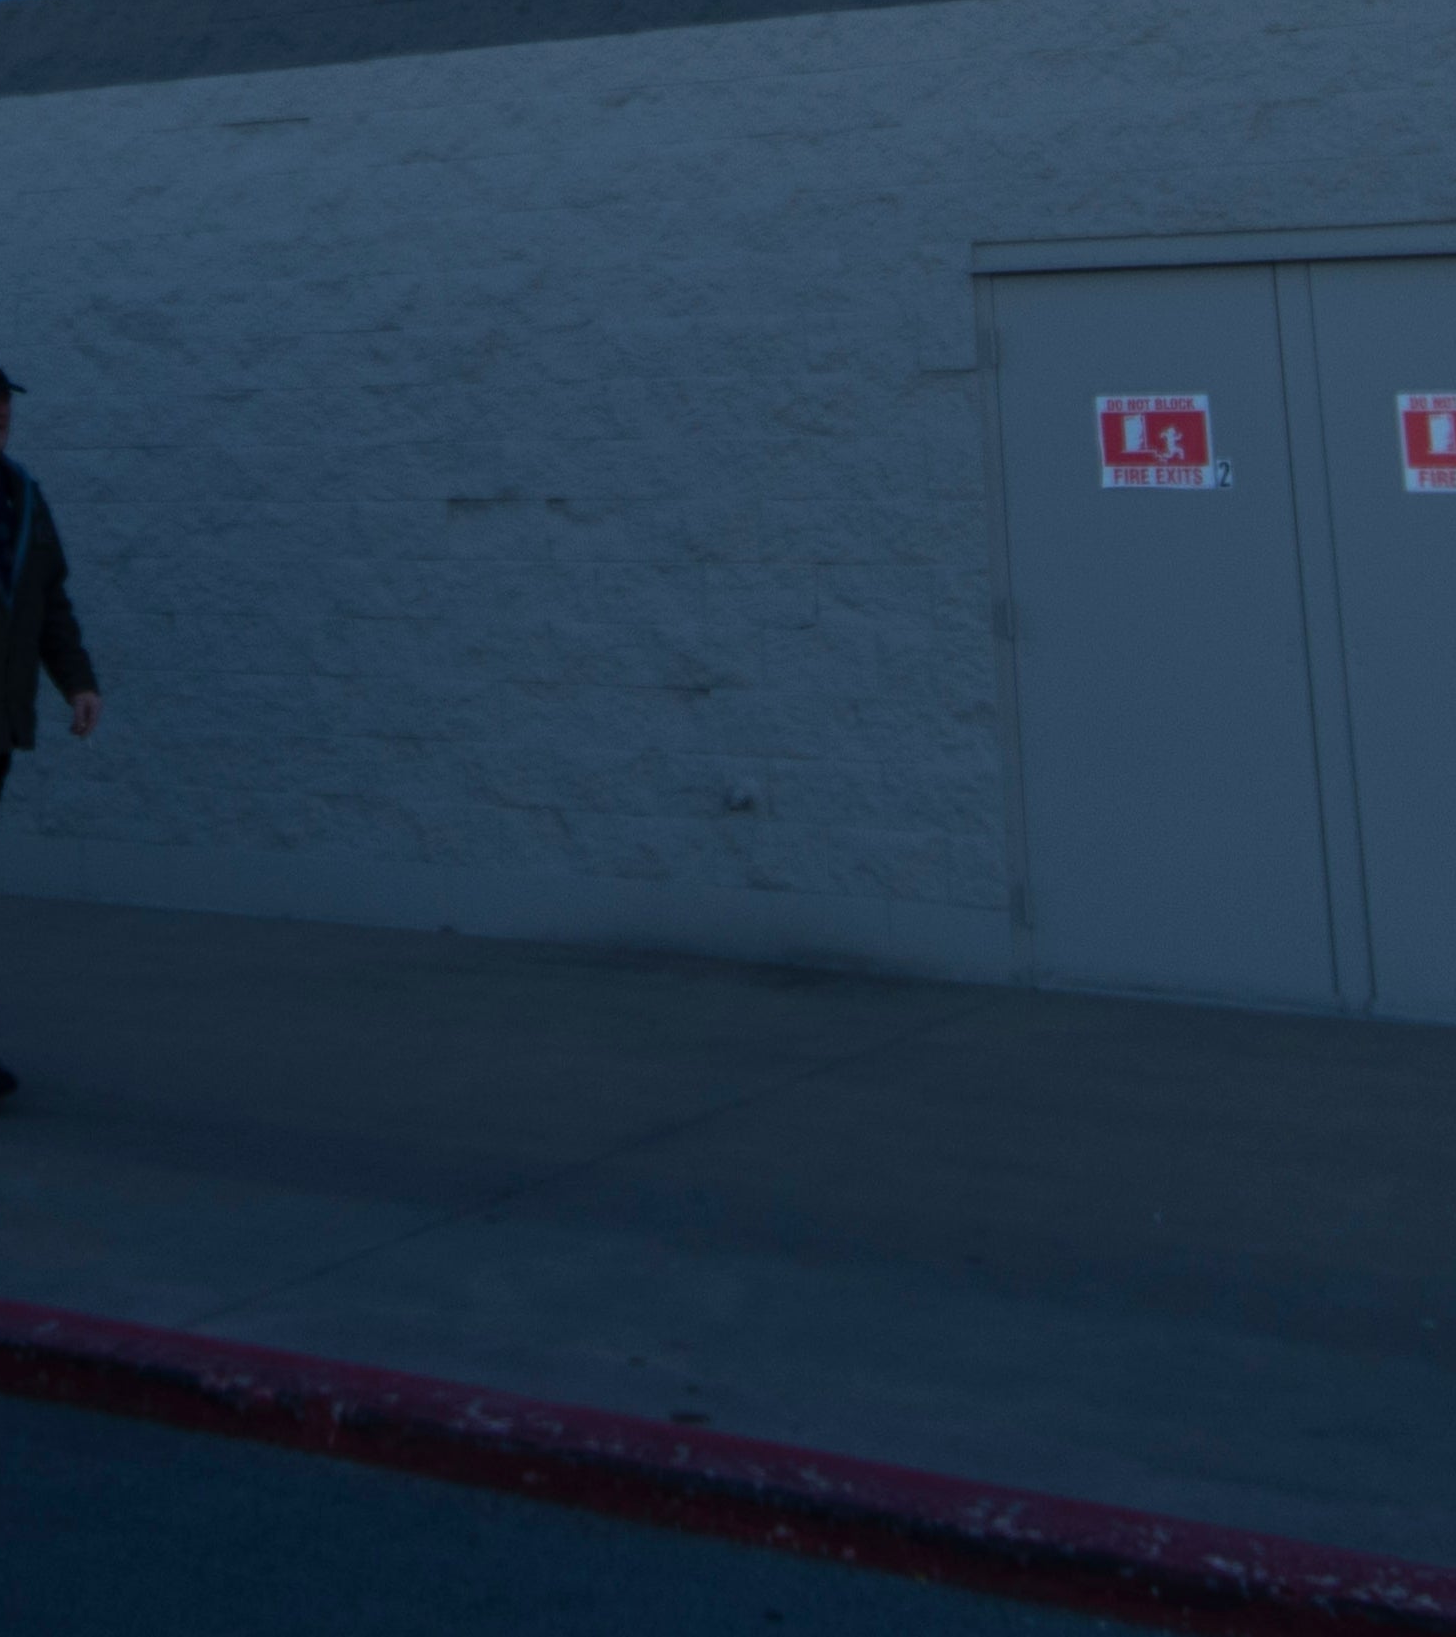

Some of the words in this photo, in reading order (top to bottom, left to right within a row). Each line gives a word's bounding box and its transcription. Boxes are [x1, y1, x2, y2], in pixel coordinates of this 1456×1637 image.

[1107, 398, 1123, 411] DO
[1127, 398, 1151, 411] NOT
[1154, 397, 1195, 411] BLOCK
[1113, 468, 1150, 485] FIRE
[1155, 468, 1203, 485] EXITS
[1218, 461, 1231, 488] 2
